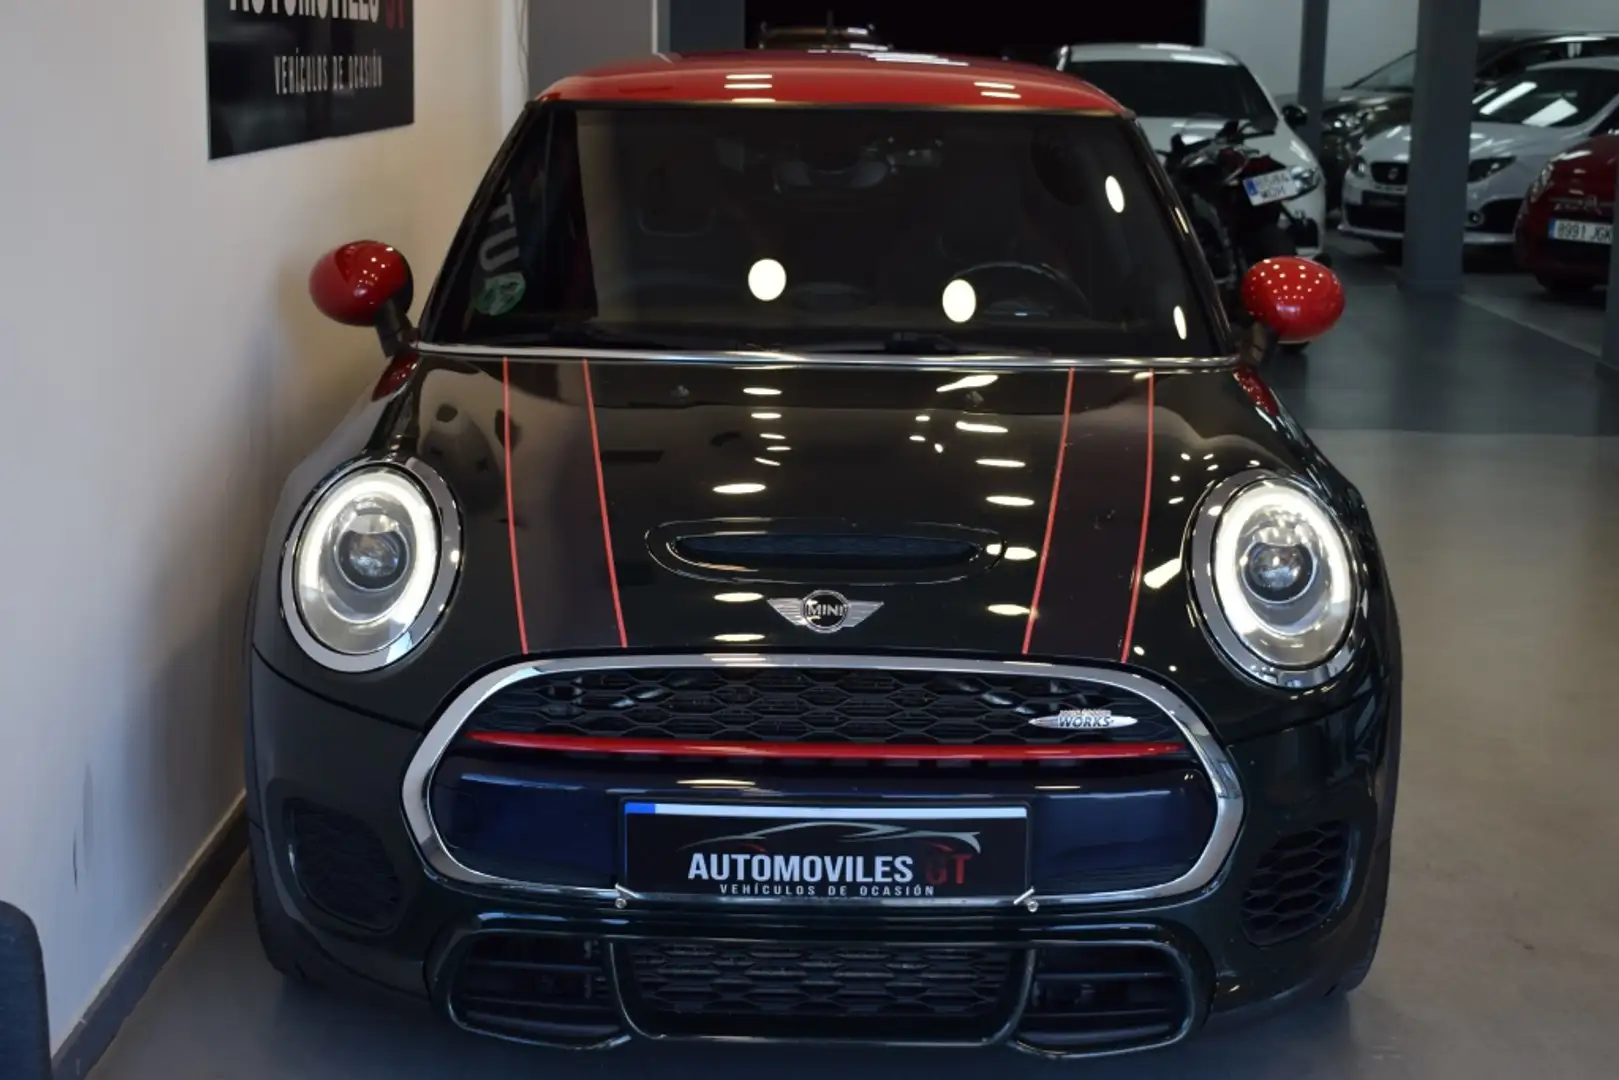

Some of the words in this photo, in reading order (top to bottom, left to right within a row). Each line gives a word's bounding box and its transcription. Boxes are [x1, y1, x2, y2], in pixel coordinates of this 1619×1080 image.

[332, 55, 345, 90] DE
[807, 604, 844, 616] MINI
[1059, 715, 1112, 727] WORKS
[688, 852, 914, 883] AUTOMOVILES
[925, 854, 973, 885] GT
[719, 883, 816, 895] VEHÍCULOS
[828, 885, 848, 897] DE
[860, 884, 935, 897] OCASIÓN
